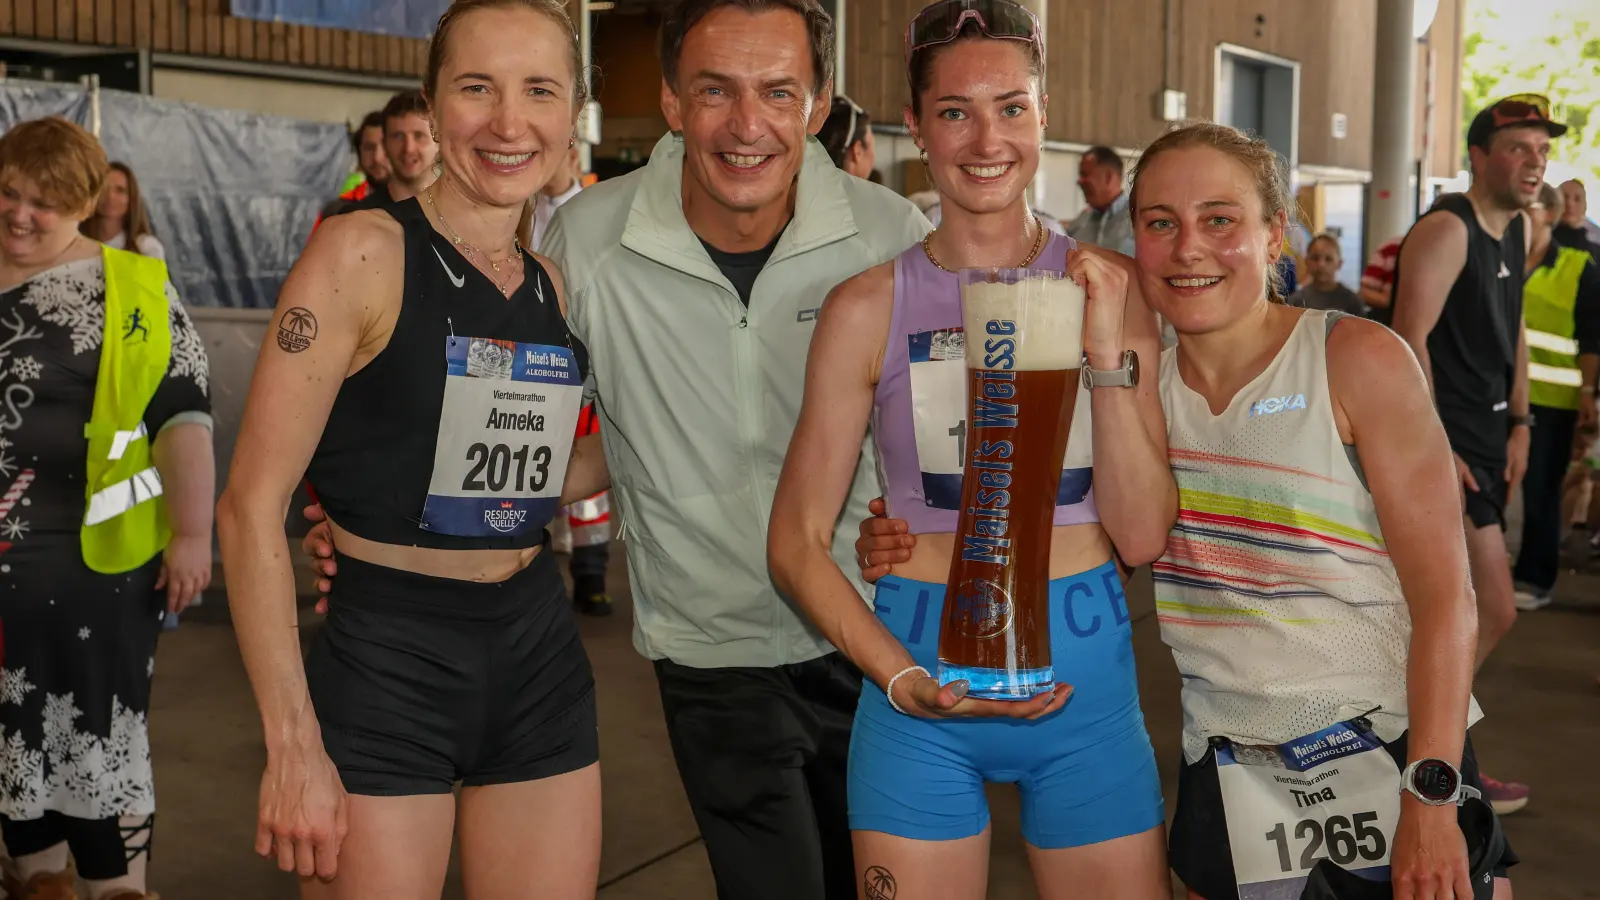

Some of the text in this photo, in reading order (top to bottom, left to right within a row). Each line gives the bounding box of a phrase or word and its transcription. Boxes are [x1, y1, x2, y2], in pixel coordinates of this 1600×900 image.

[526, 350, 549, 365] Maisel's
[525, 368, 569, 379] ALKOHOLFREI
[973, 319, 1018, 428] Weisse
[493, 390, 546, 403] Viertelmarathon
[1248, 393, 1307, 418] HOKA
[486, 408, 545, 432] Anneka
[461, 442, 552, 492] 2013
[962, 439, 1014, 566] Maisel's
[484, 510, 527, 523] RESIDENZ
[490, 519, 516, 528] QUELLE
[1292, 739, 1328, 759] Maisel's
[1301, 741, 1363, 767] ALKOHOLFREI
[1273, 766, 1340, 787] Viertelmarathon
[1290, 785, 1336, 809] Tina
[1265, 810, 1387, 873] 1265
